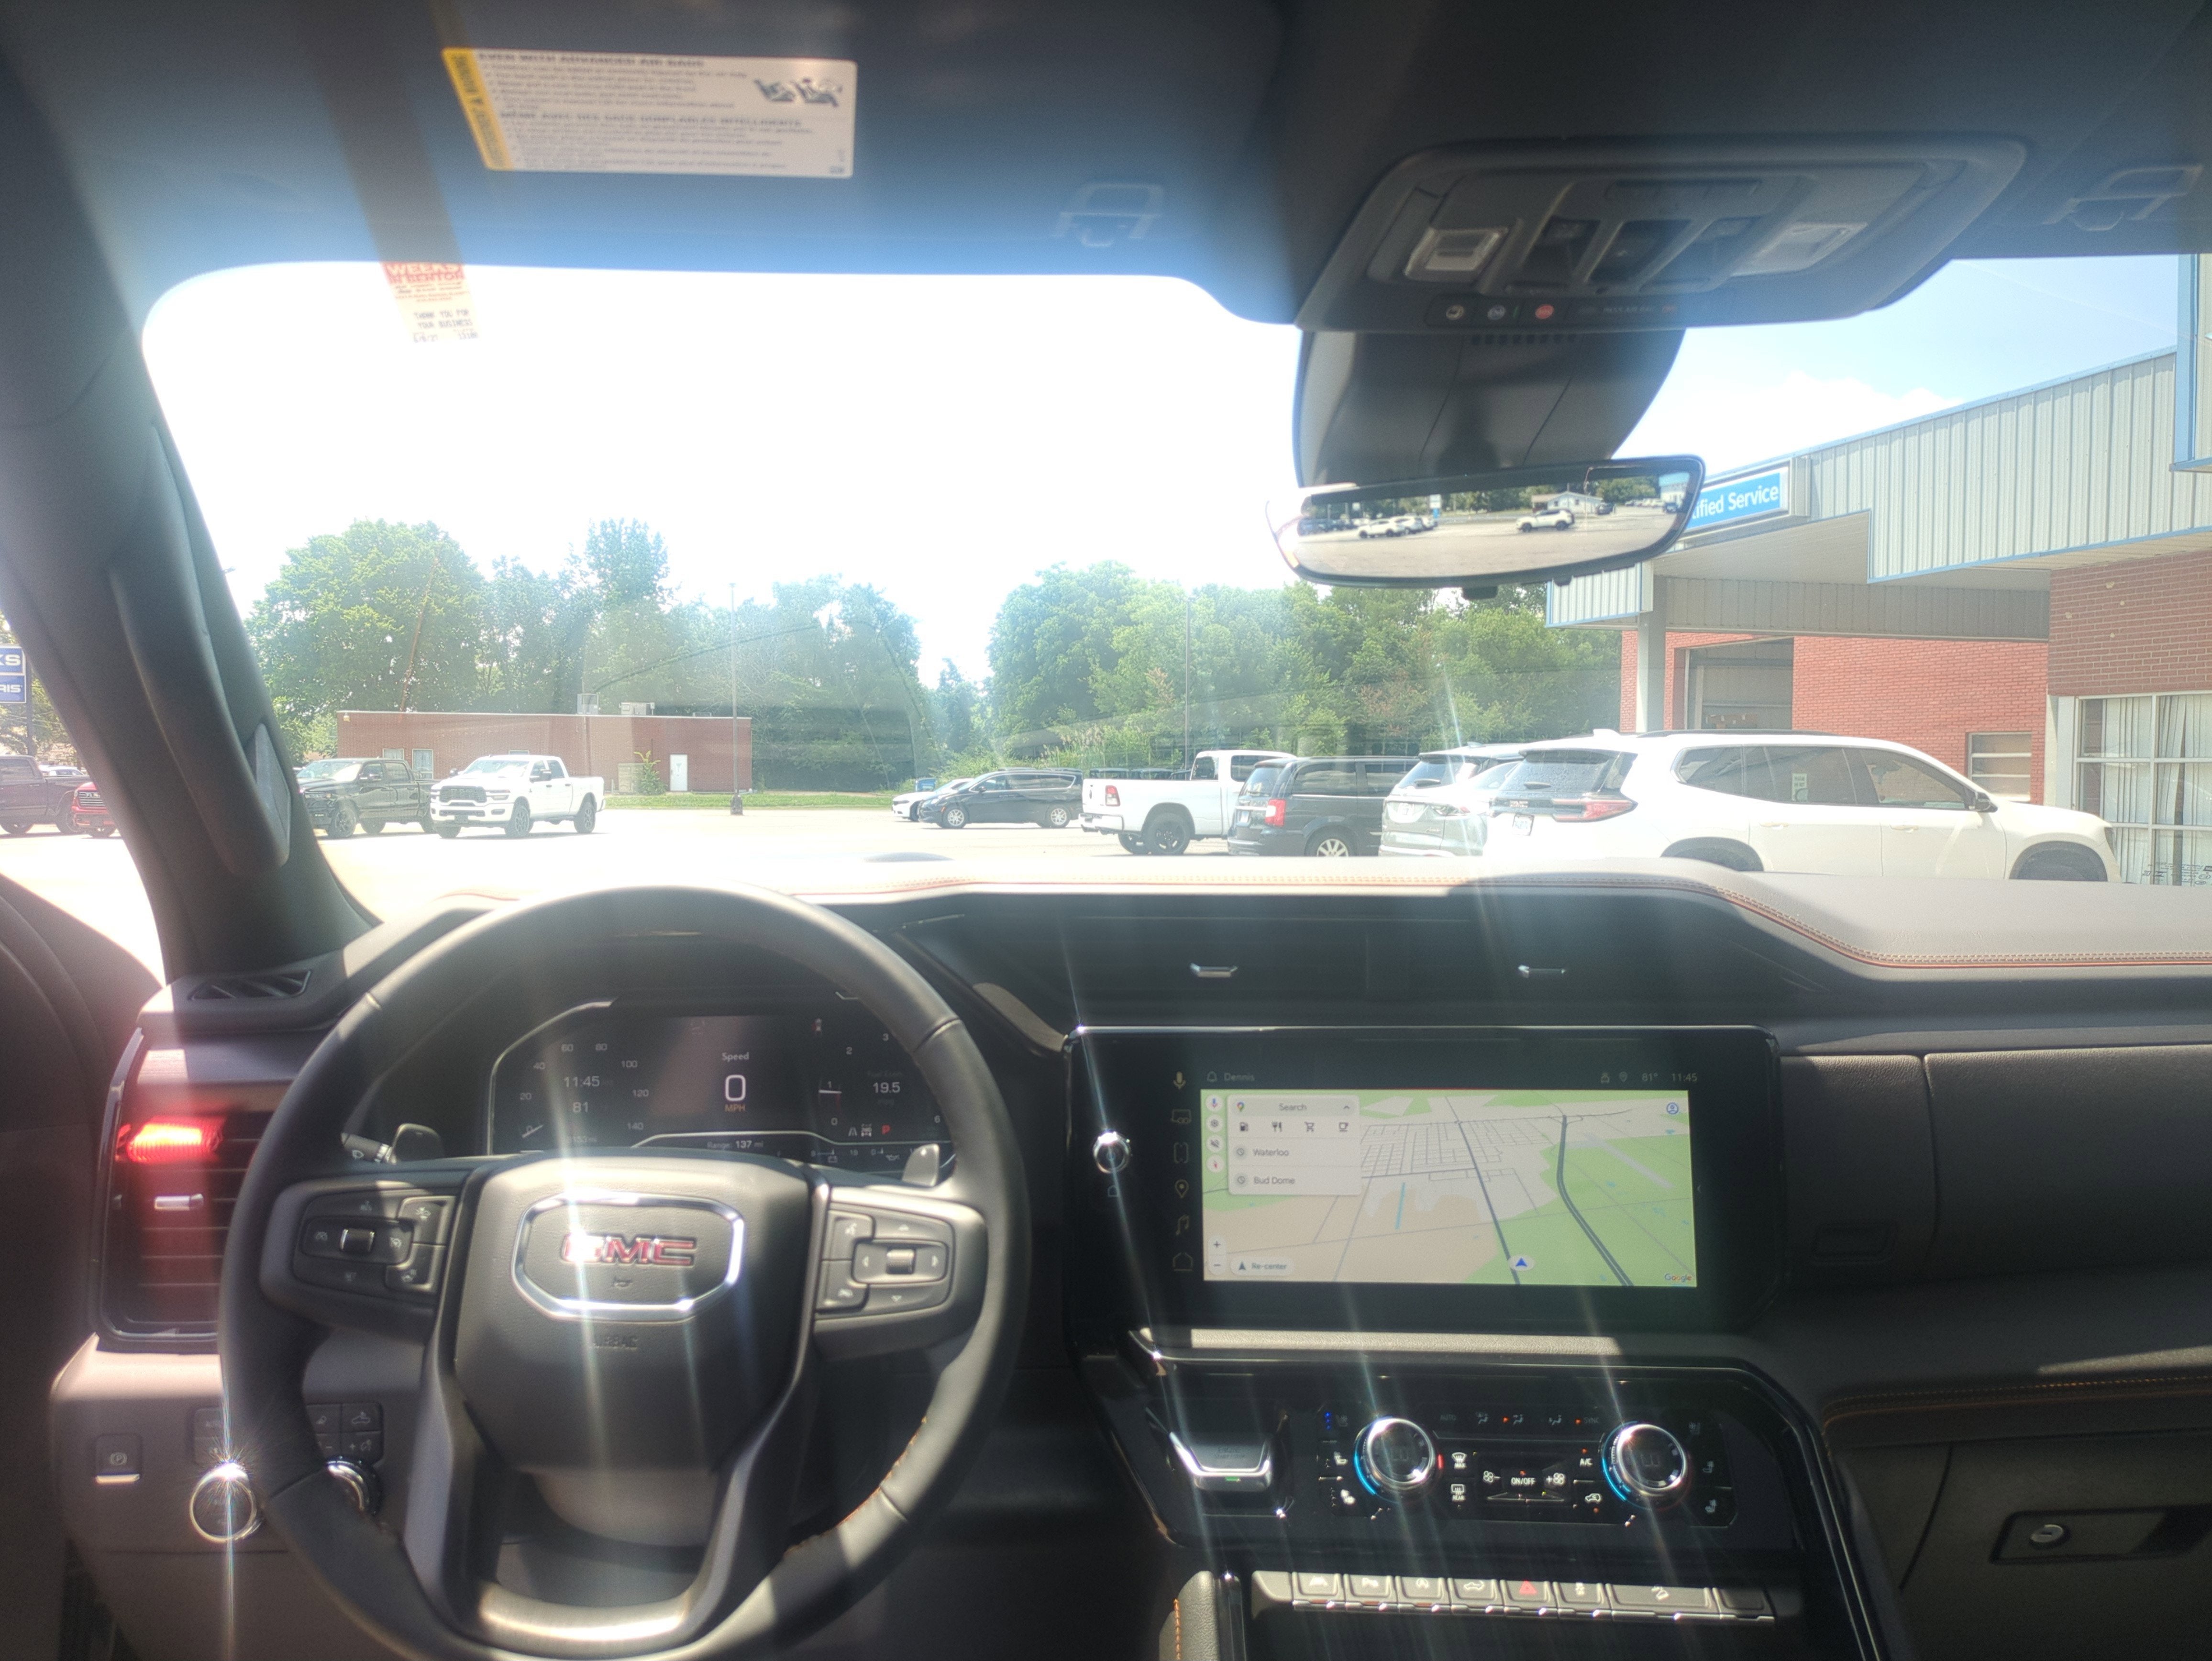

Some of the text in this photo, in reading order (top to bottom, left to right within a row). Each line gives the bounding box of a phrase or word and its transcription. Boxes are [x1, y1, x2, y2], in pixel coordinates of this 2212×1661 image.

[1728, 485, 1780, 510] Service
[882, 1033, 889, 1041] 3
[561, 1043, 574, 1052] 60
[845, 1046, 853, 1056] 2
[721, 1052, 750, 1063] Speed
[533, 1062, 546, 1070] 40
[621, 1060, 638, 1068] 100
[1224, 1072, 1255, 1081] Dennis
[1671, 1073, 1698, 1082] 11:45
[563, 1075, 600, 1088] 11:45
[827, 1080, 832, 1089] 1
[724, 1074, 747, 1102] 0
[872, 1081, 901, 1094] 19.5
[520, 1092, 532, 1100] 20
[632, 1089, 650, 1097] 120
[572, 1101, 589, 1113] 81
[724, 1104, 746, 1113] MPH
[1279, 1103, 1307, 1112] Search
[830, 1118, 838, 1126] 0
[934, 1115, 941, 1124] 6
[627, 1122, 644, 1130] 140
[881, 1124, 891, 1135] P
[735, 1140, 752, 1149] 137
[1252, 1148, 1289, 1157] Waterloo
[1253, 1176, 1295, 1185] Bud Dome
[561, 1231, 697, 1267] GMC
[1251, 1262, 1287, 1271] Re-center
[1664, 1273, 1692, 1283] Google
[1580, 1458, 1593, 1466] A/C
[1510, 1477, 1536, 1486] ON/OFF
